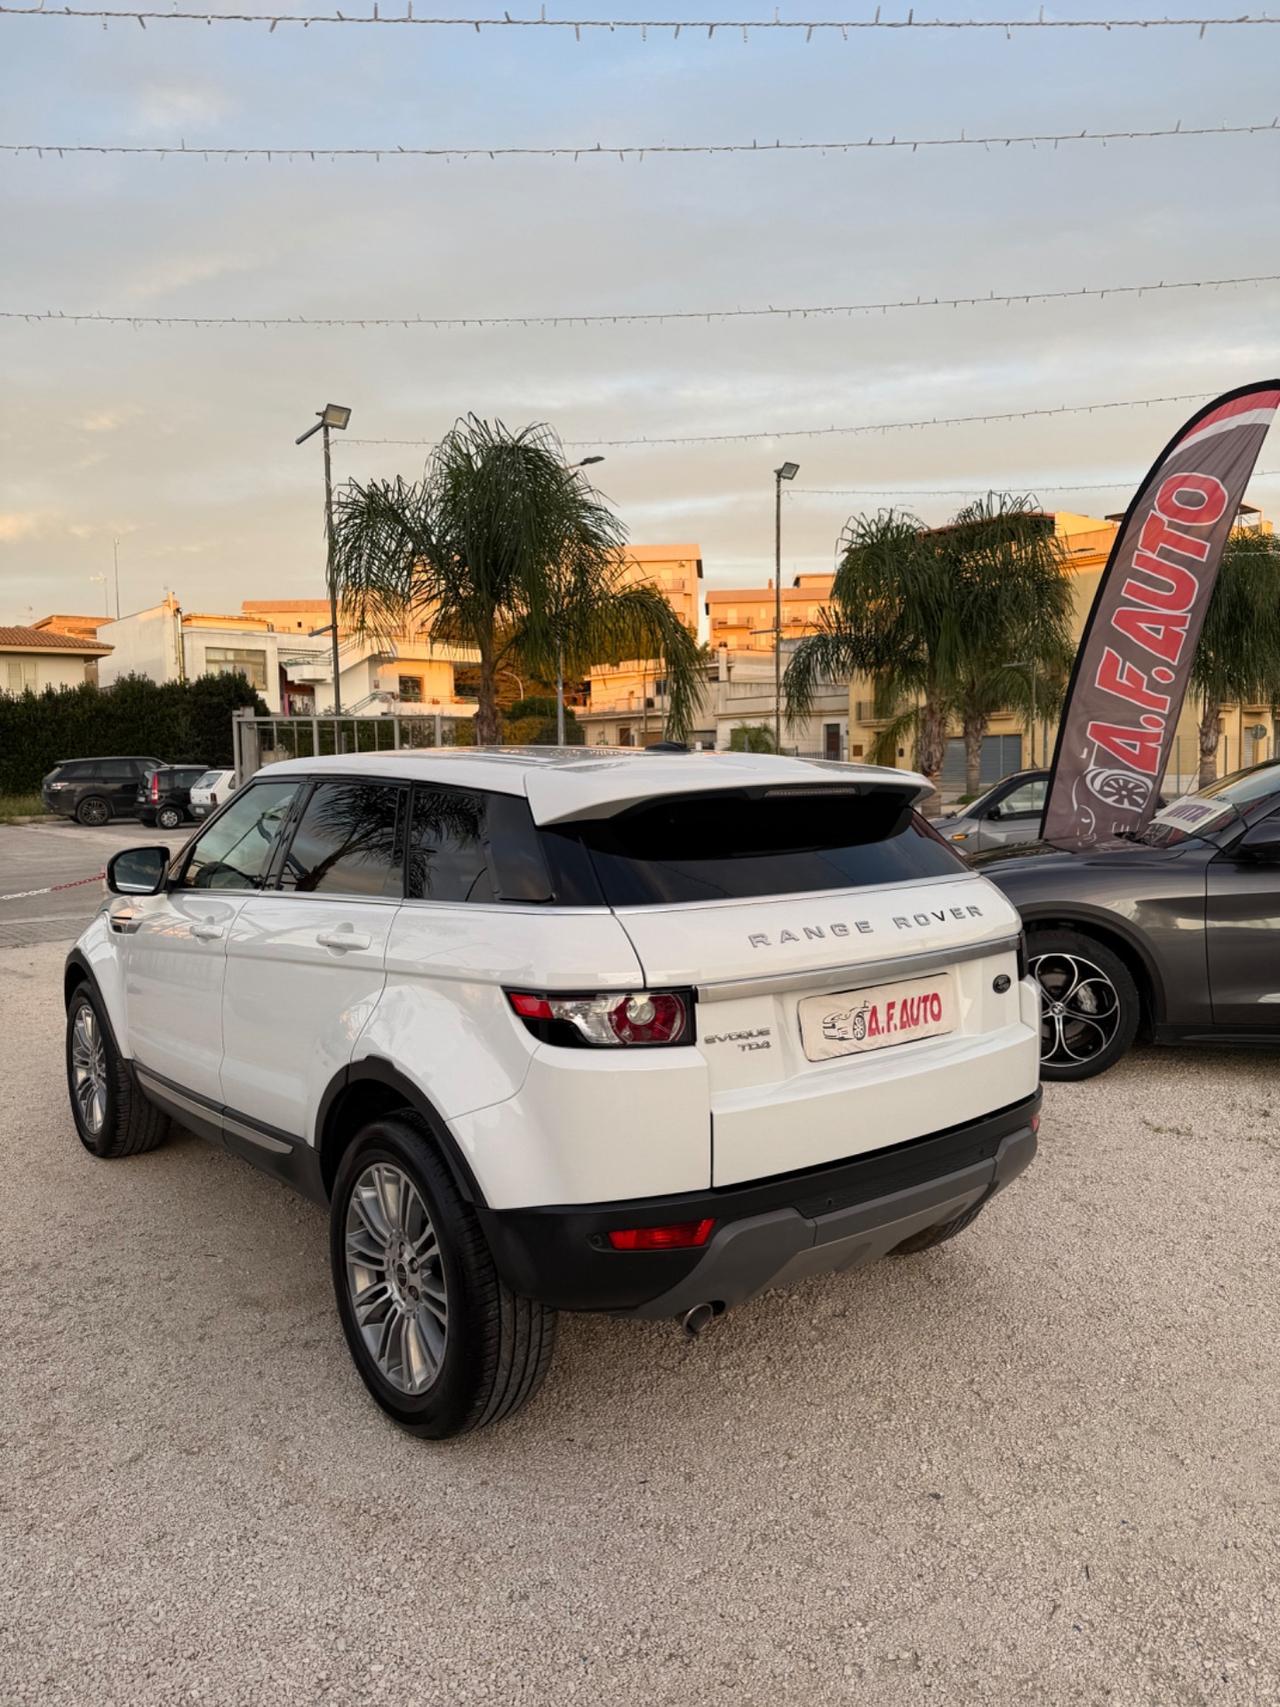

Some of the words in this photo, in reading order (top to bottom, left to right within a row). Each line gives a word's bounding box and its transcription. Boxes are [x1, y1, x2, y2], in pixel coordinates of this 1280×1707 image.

[1087, 472, 1228, 775] A.F.AUTO
[748, 920, 873, 948] RANGE
[892, 905, 984, 929] ROVER
[867, 992, 943, 1037] A.F.AUTO
[704, 1028, 771, 1045] EVOQUE
[737, 1040, 772, 1052] TD4
